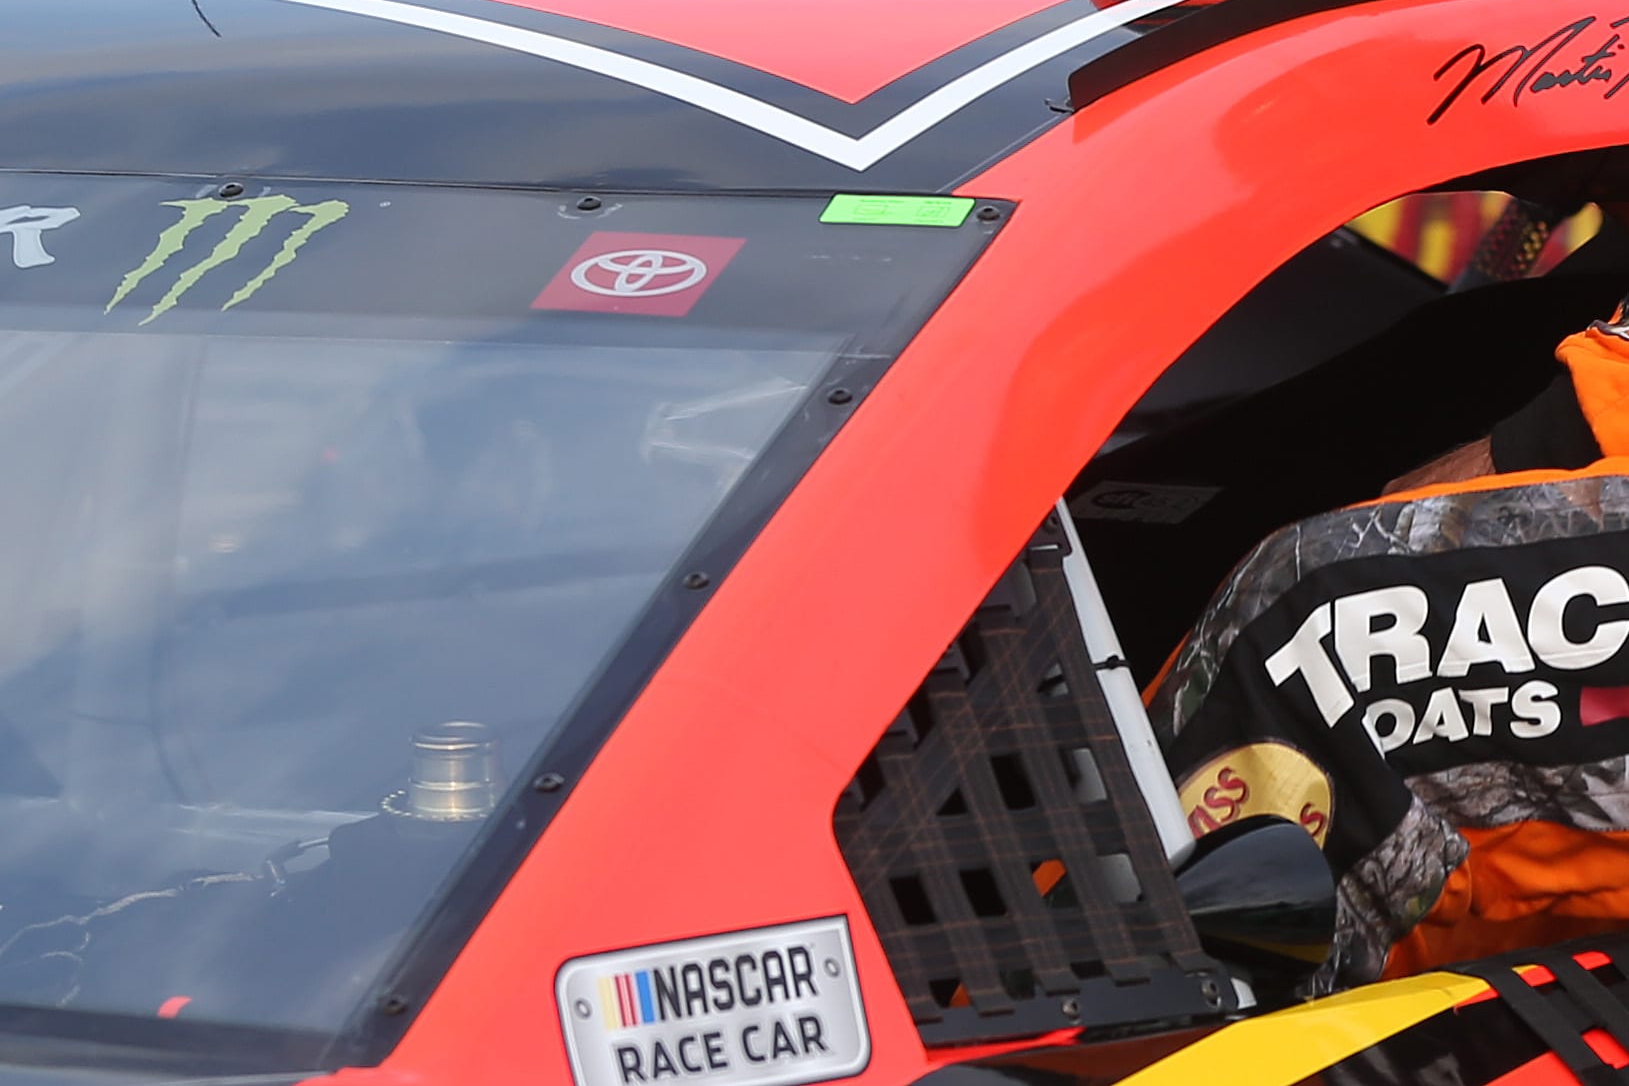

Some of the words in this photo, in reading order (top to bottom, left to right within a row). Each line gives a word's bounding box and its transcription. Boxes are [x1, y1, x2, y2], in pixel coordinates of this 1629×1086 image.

[652, 945, 818, 1022] NASCAR
[617, 1031, 729, 1083] RACE
[741, 1015, 830, 1063] CAR
